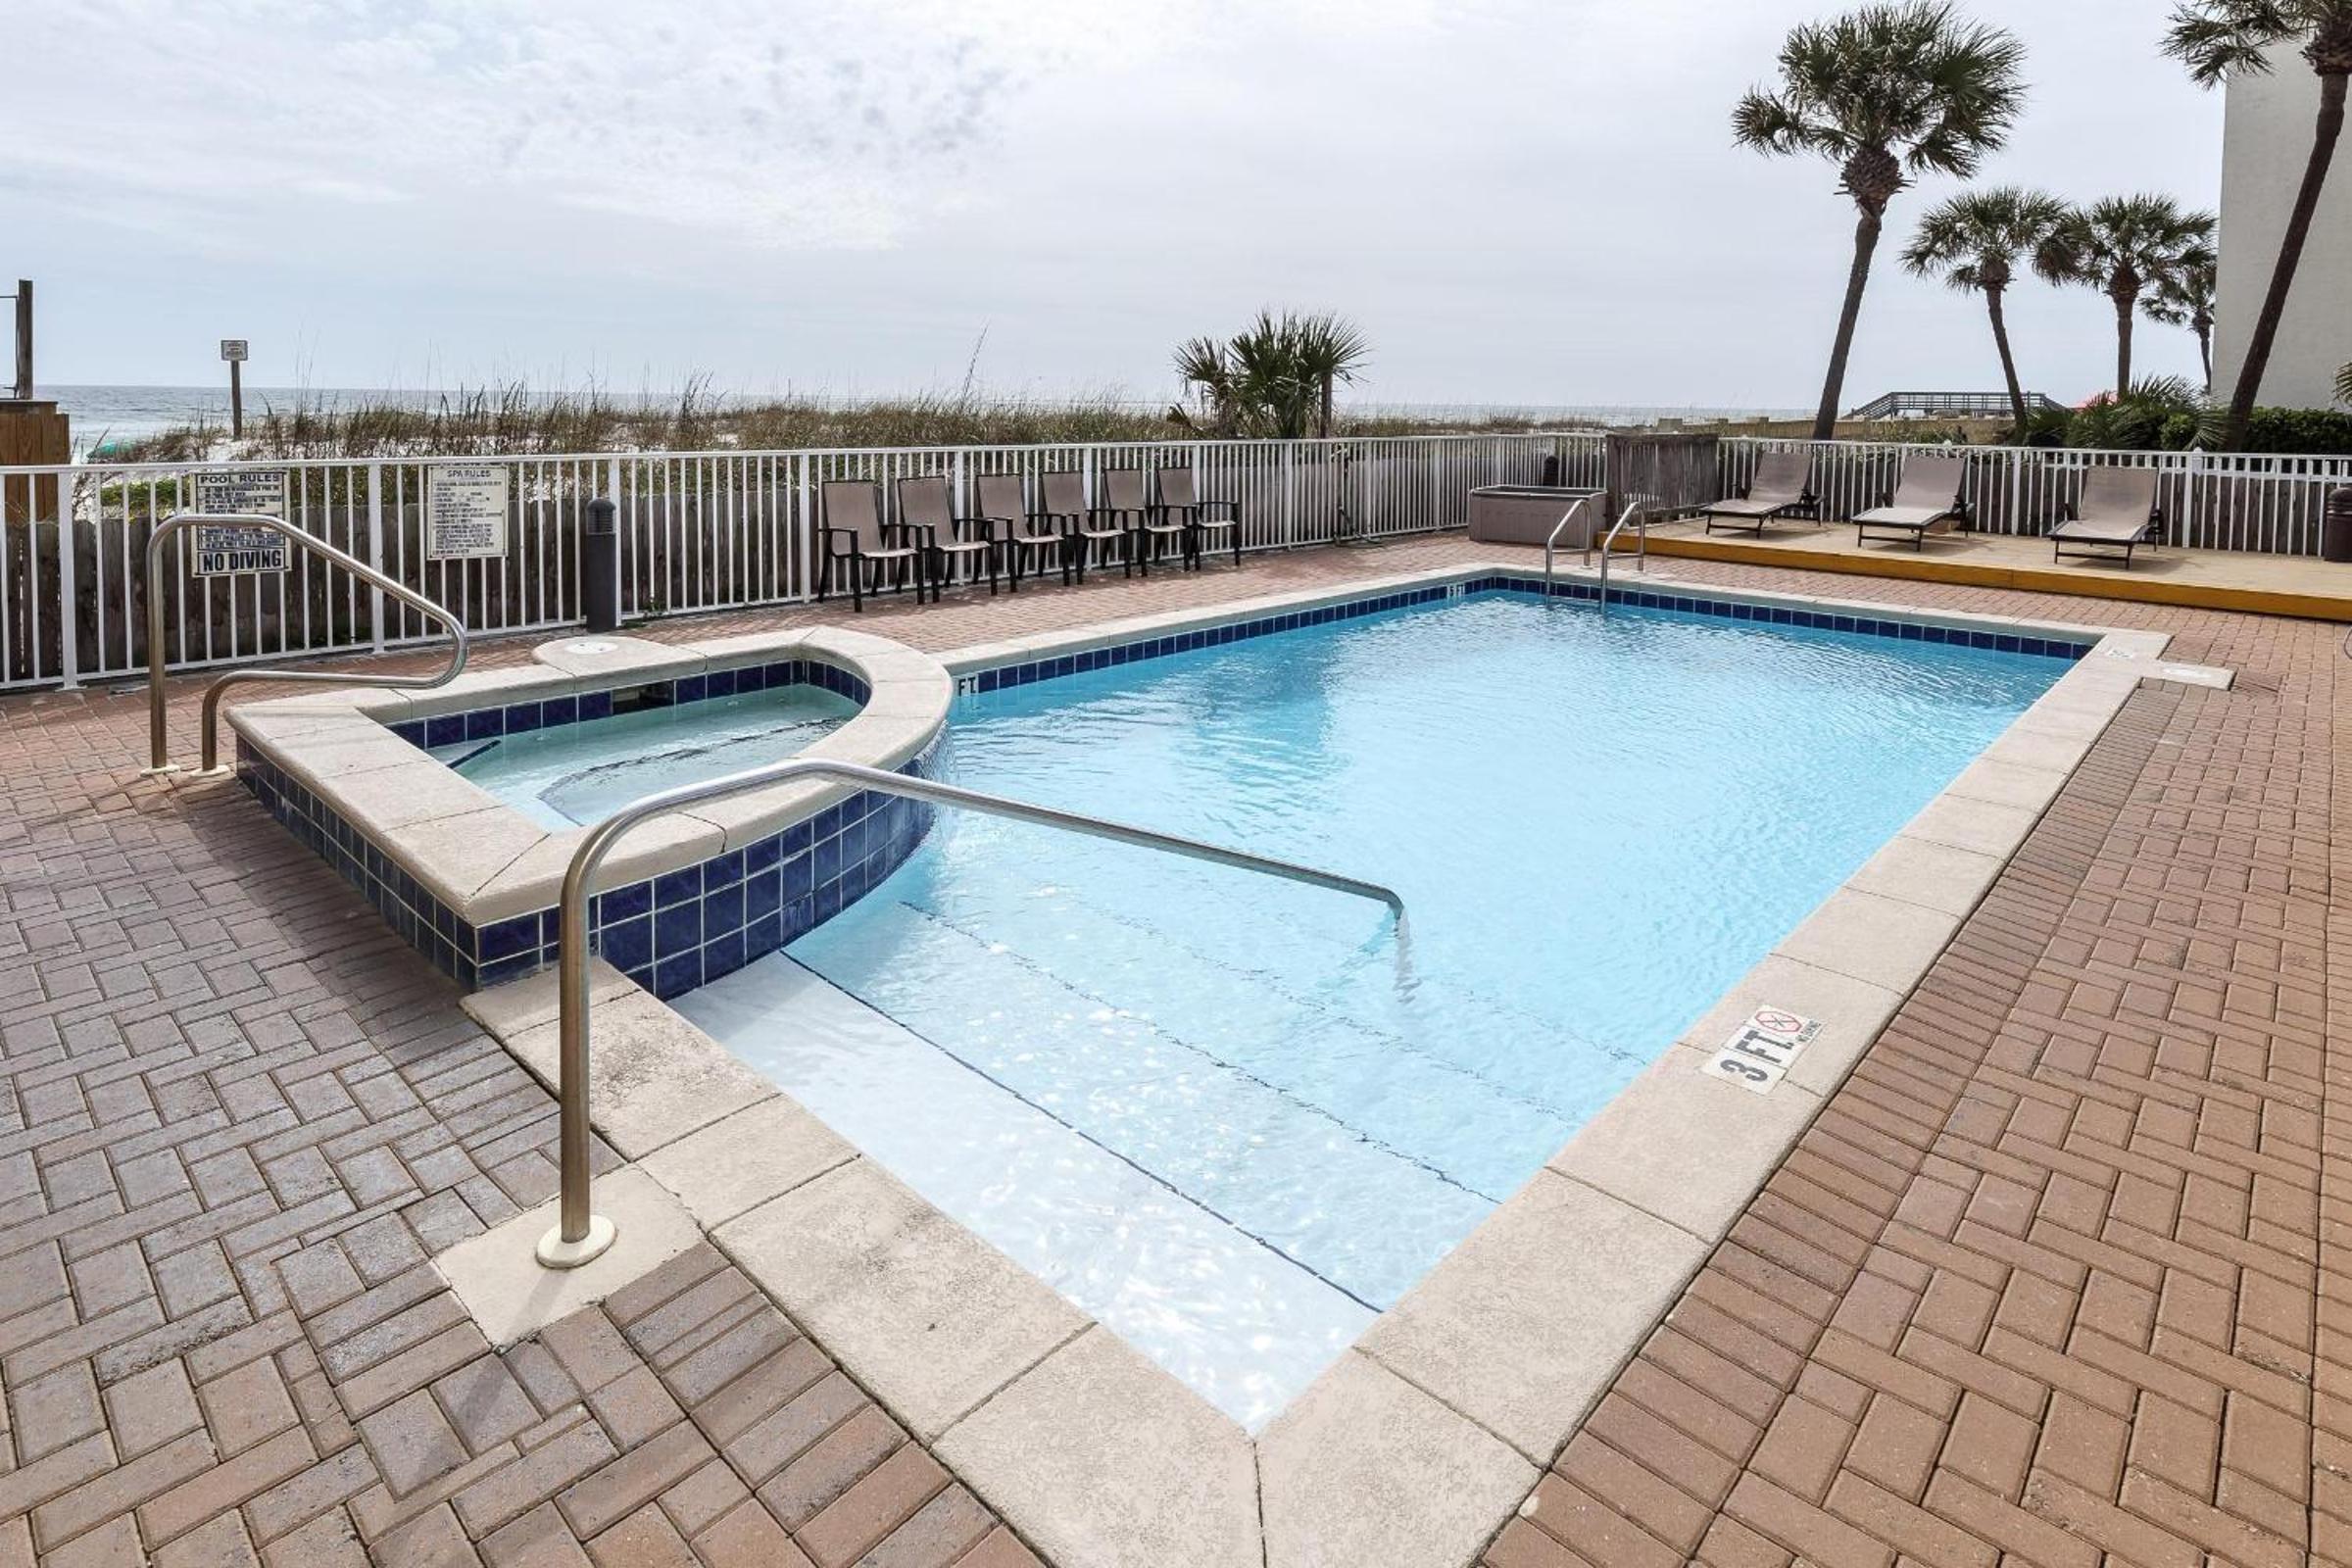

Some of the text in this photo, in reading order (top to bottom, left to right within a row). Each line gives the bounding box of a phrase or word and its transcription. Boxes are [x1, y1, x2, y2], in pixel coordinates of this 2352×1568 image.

[200, 474, 279, 484] POOL RULES
[447, 469, 492, 478] SPA RULES
[203, 550, 282, 572] NO DIVING
[1720, 1058, 1768, 1082] 3
